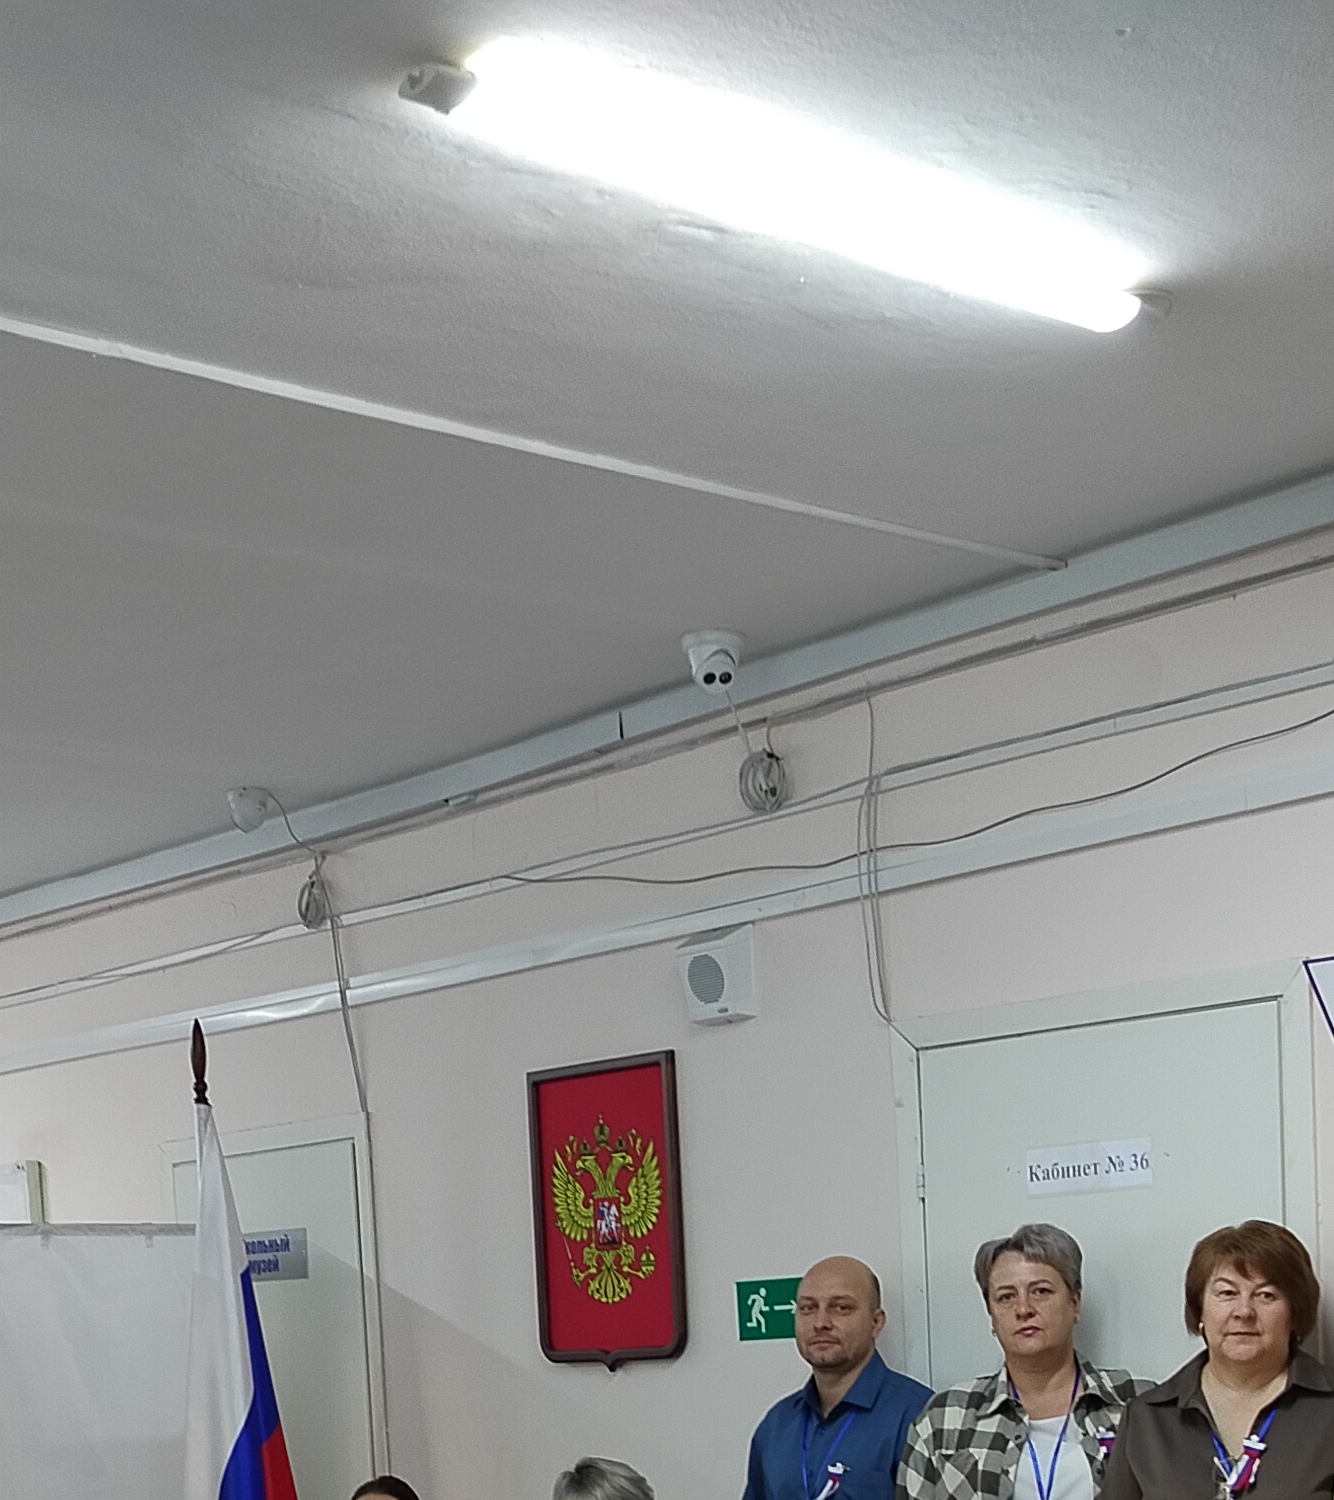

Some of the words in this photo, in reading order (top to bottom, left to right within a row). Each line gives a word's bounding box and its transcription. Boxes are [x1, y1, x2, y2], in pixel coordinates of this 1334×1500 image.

[1028, 1162, 1101, 1183] Кабинет
[1105, 1154, 1125, 1174] №
[1129, 1152, 1150, 1171] 36
[242, 1232, 291, 1256] кольный
